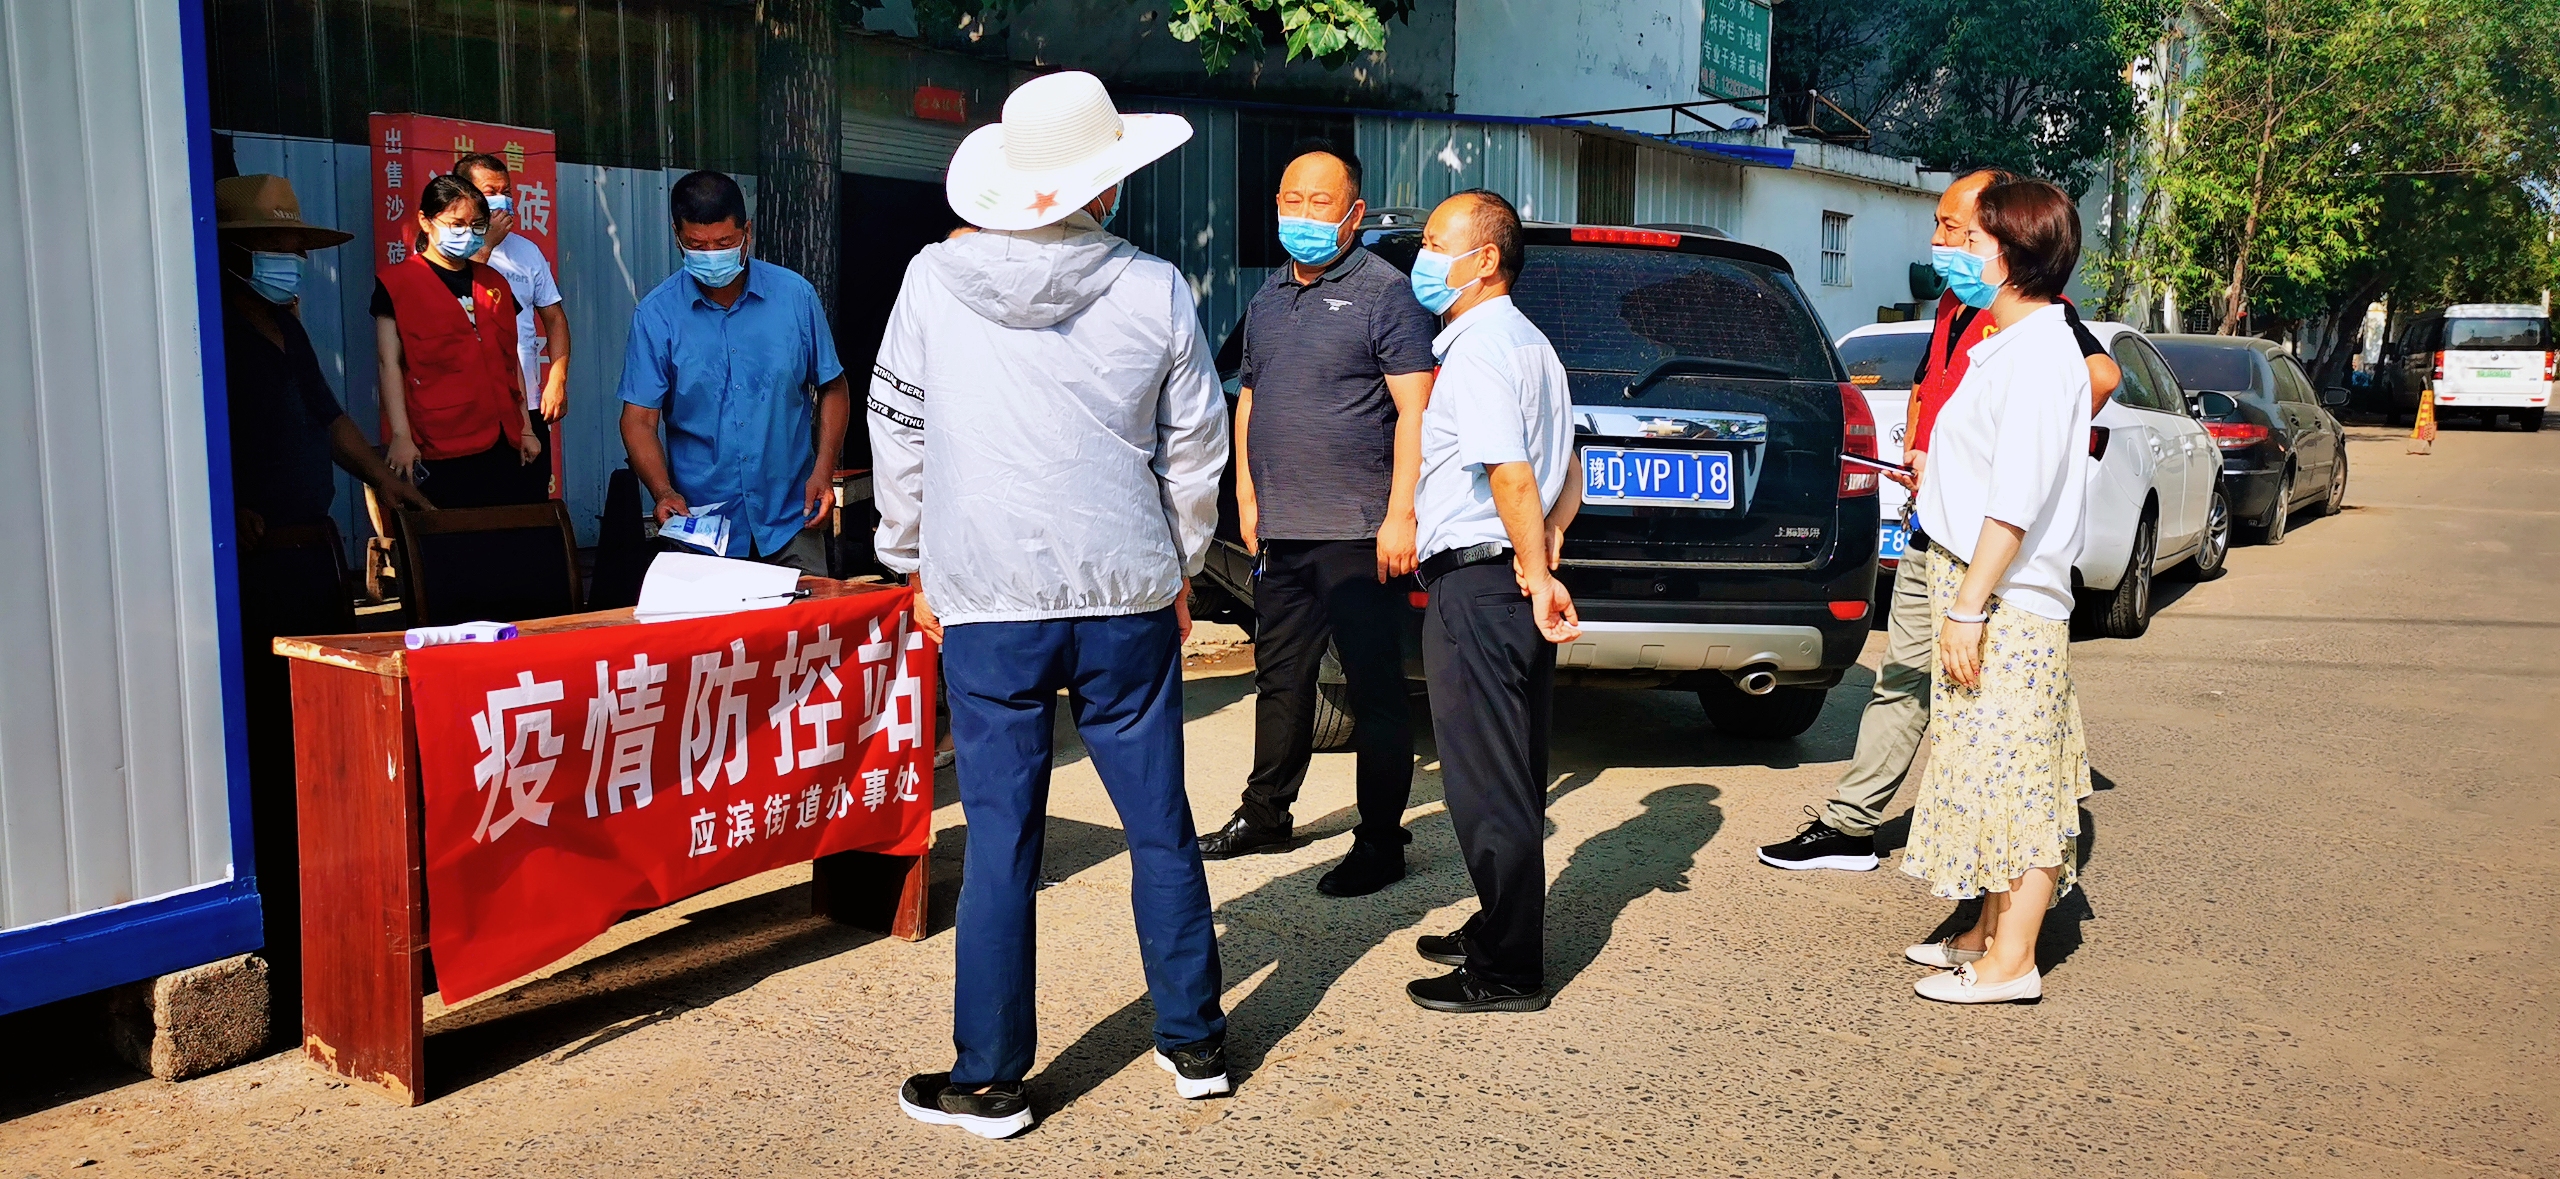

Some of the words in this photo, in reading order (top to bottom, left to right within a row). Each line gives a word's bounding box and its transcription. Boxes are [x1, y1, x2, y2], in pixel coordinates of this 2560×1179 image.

[891, 411, 925, 428] ARTHU
[1879, 528, 1912, 552] F8
[471, 610, 923, 844] 疫情防控站
[688, 762, 920, 859] 应滨街道办事处
